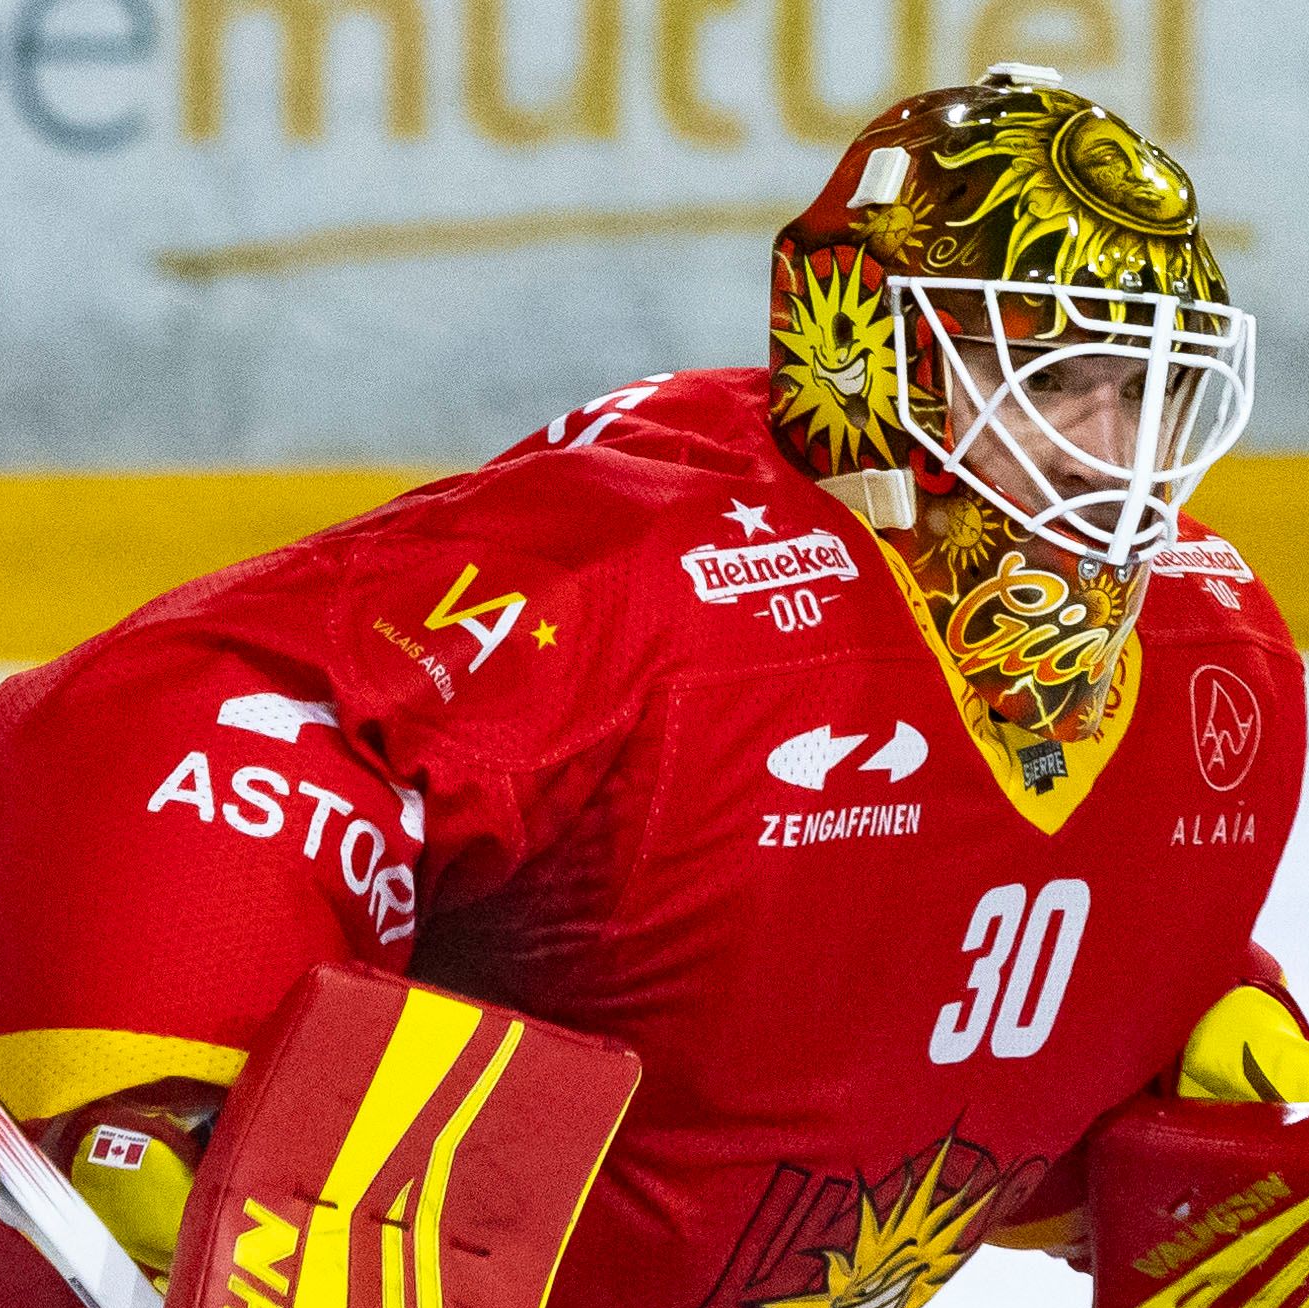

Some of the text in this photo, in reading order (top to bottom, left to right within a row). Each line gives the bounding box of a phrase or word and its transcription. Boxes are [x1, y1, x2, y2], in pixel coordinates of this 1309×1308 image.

[696, 539, 849, 590] Heineken
[1153, 546, 1244, 571] eineken
[372, 617, 456, 704] VALAIS ARENA
[757, 802, 923, 848] ZENGAFFINEN
[927, 877, 1092, 1065] 30
